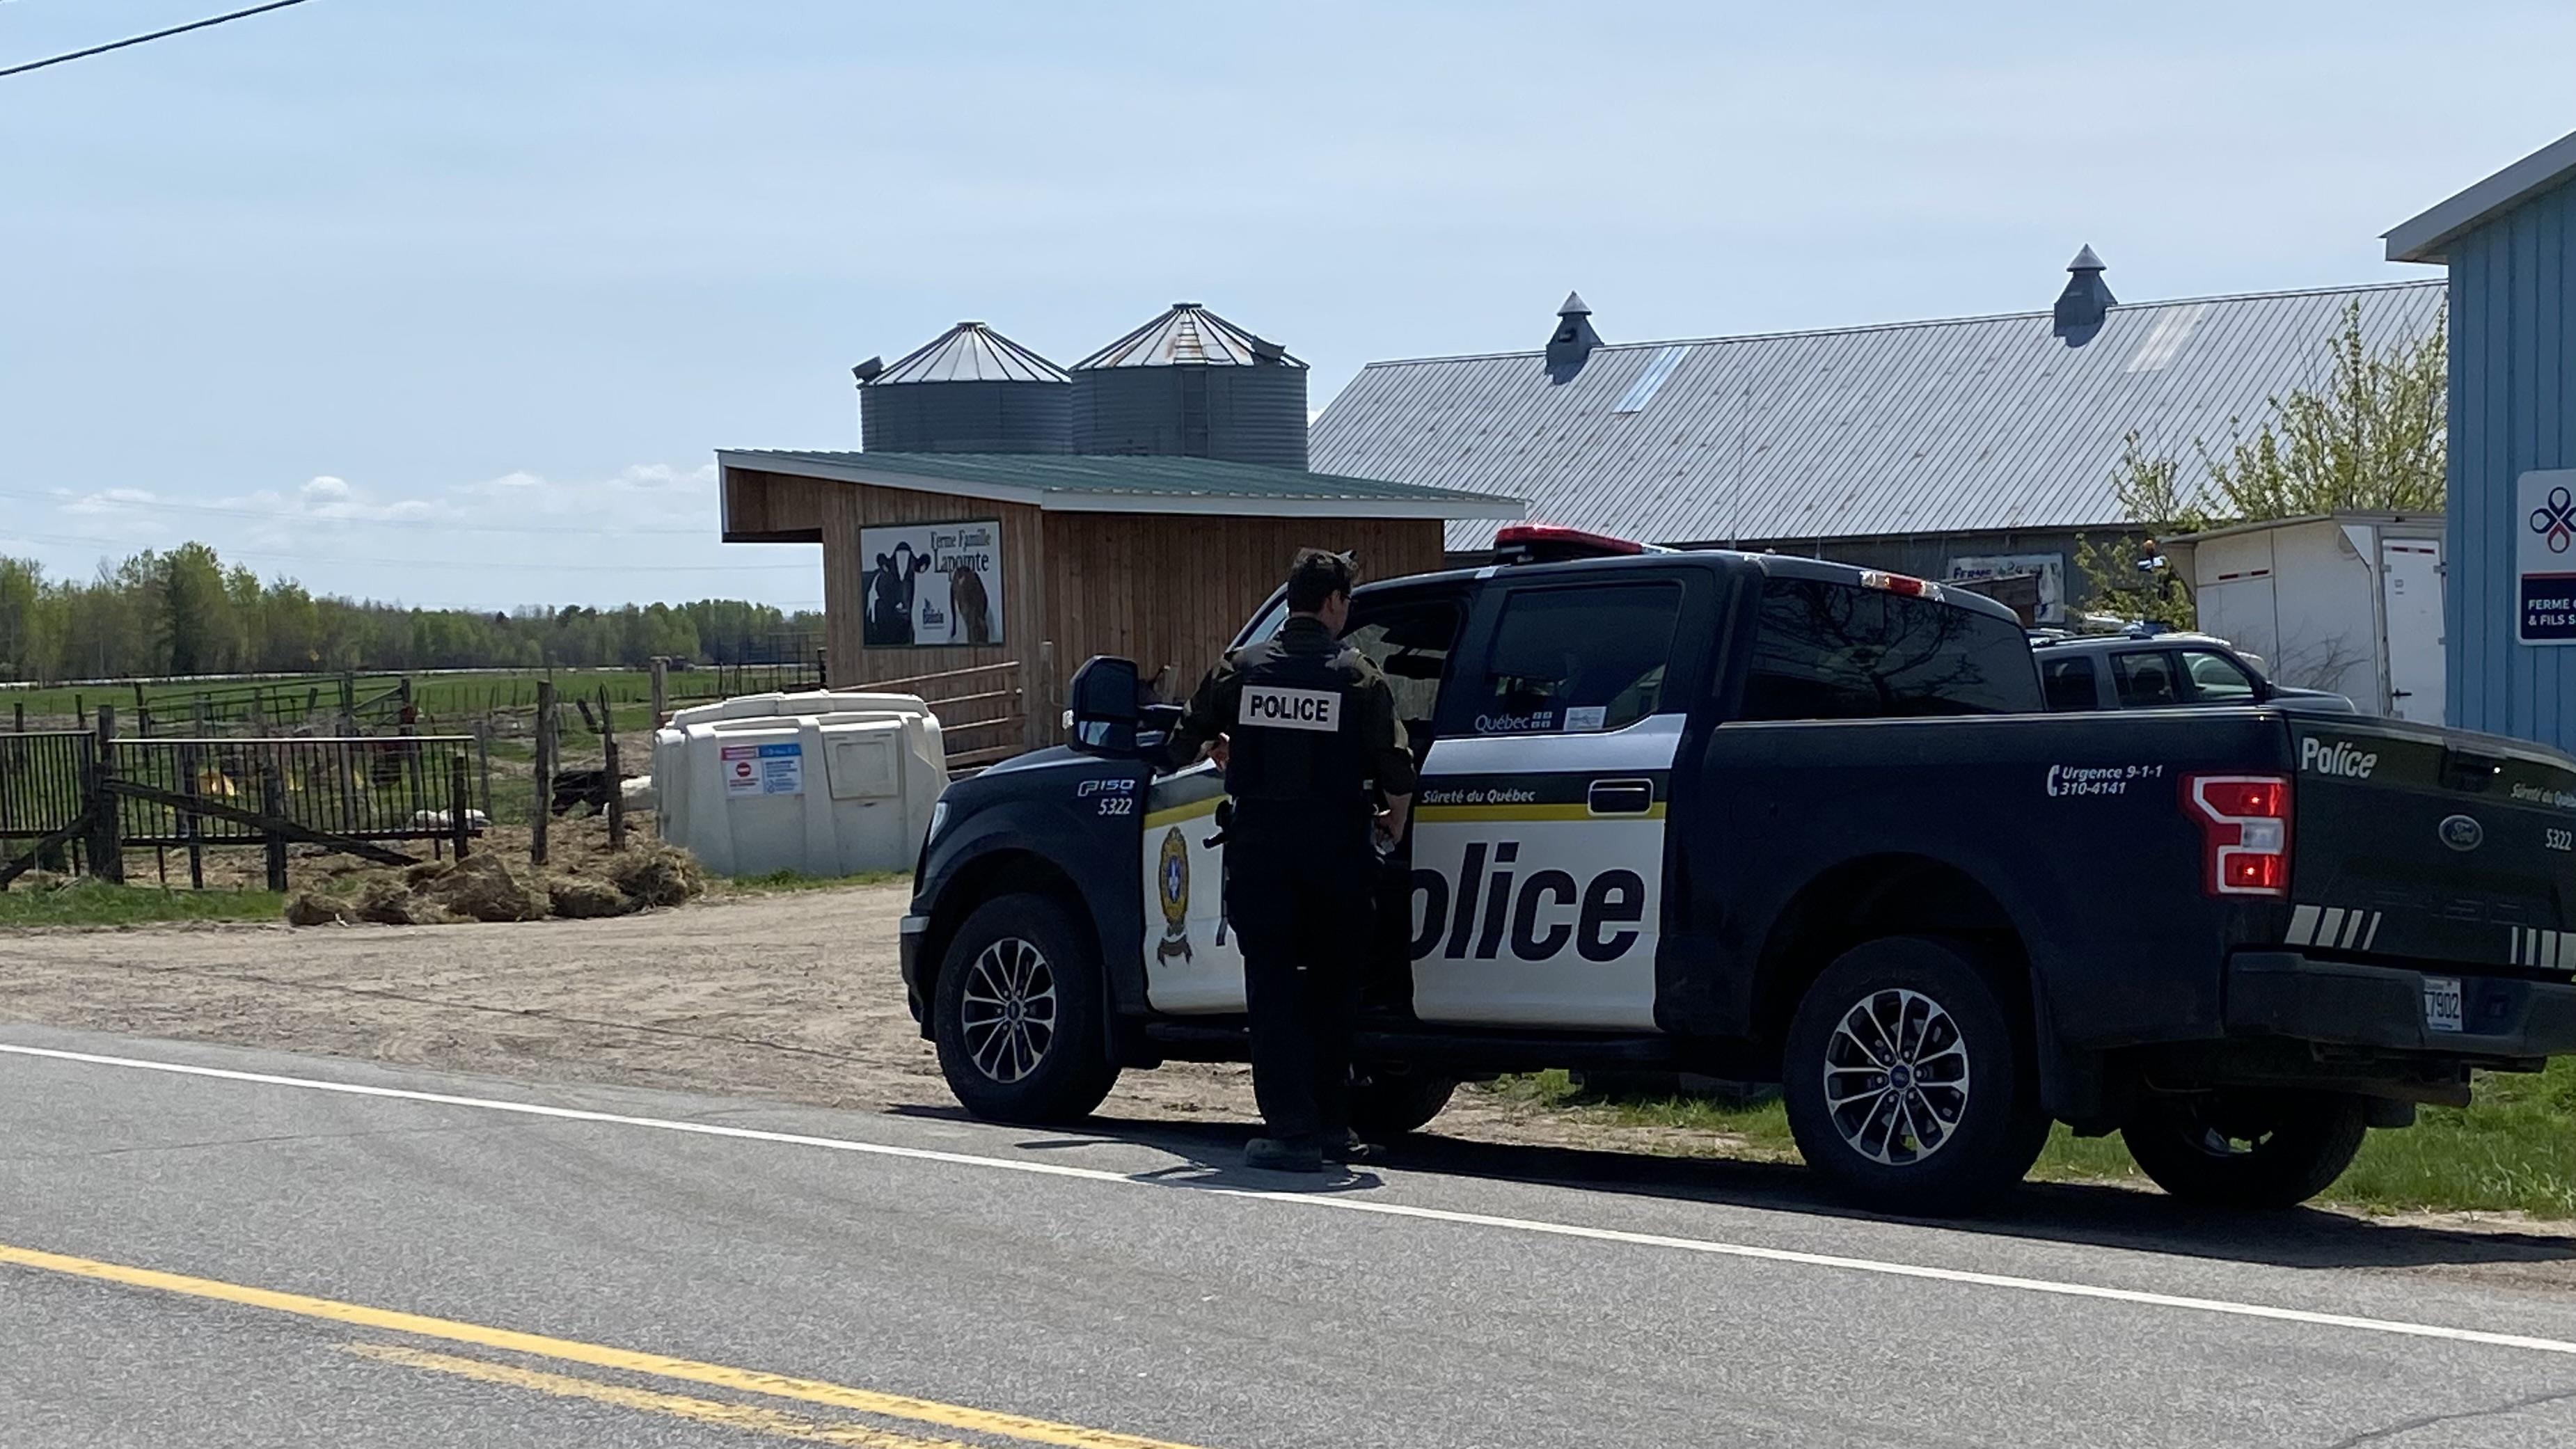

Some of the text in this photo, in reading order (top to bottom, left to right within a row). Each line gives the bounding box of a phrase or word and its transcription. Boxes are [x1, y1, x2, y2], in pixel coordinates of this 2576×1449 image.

[2528, 598, 2570, 610] FERME
[2528, 615, 2537, 626] &
[2540, 614, 2566, 626] FILS
[1251, 695, 1330, 722] POLICE
[1475, 714, 1530, 734] Québec
[2301, 737, 2378, 779] Police
[2062, 765, 2163, 782] Urgence 9-1-1
[1422, 788, 1536, 804] Sûreté du Québec
[2060, 782, 2126, 795] 310-4141
[1098, 798, 1132, 816] 5322
[2545, 828, 2572, 850] 5322
[2424, 991, 2460, 1019] 7902
